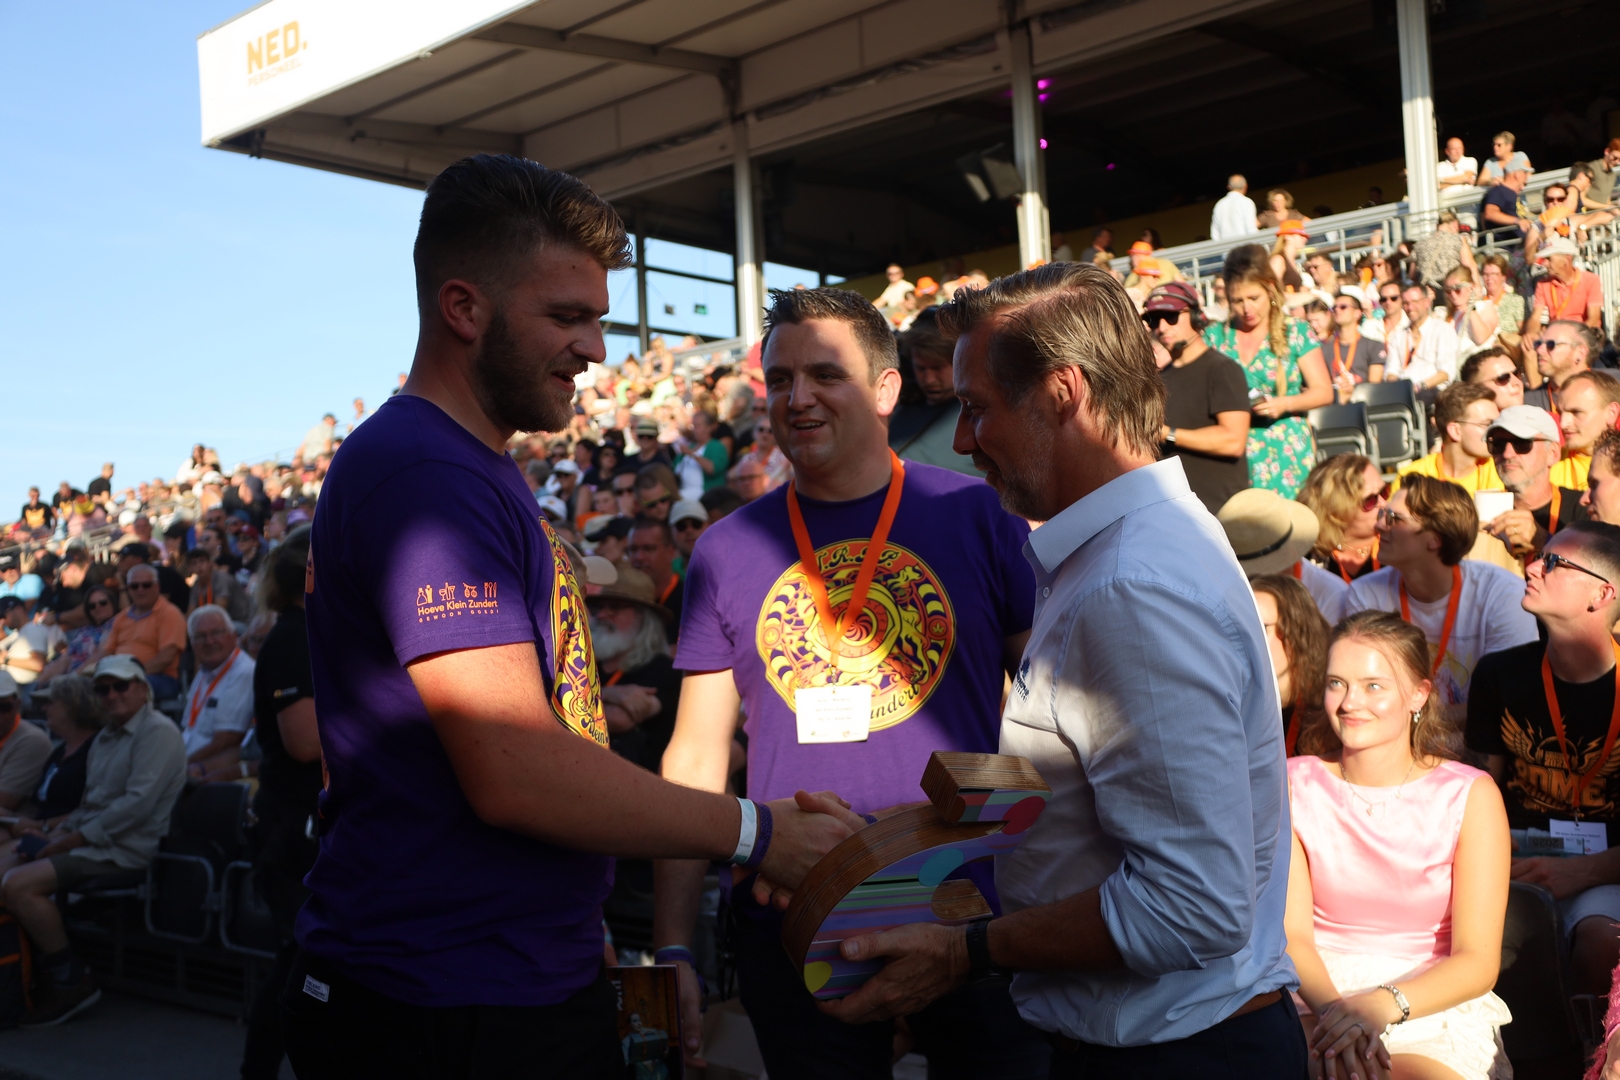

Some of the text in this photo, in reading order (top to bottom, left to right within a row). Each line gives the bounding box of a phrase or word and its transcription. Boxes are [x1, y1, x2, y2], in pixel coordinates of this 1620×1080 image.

[247, 20, 308, 75] NED.
[417, 599, 499, 616] Hoeve Klein Zundert
